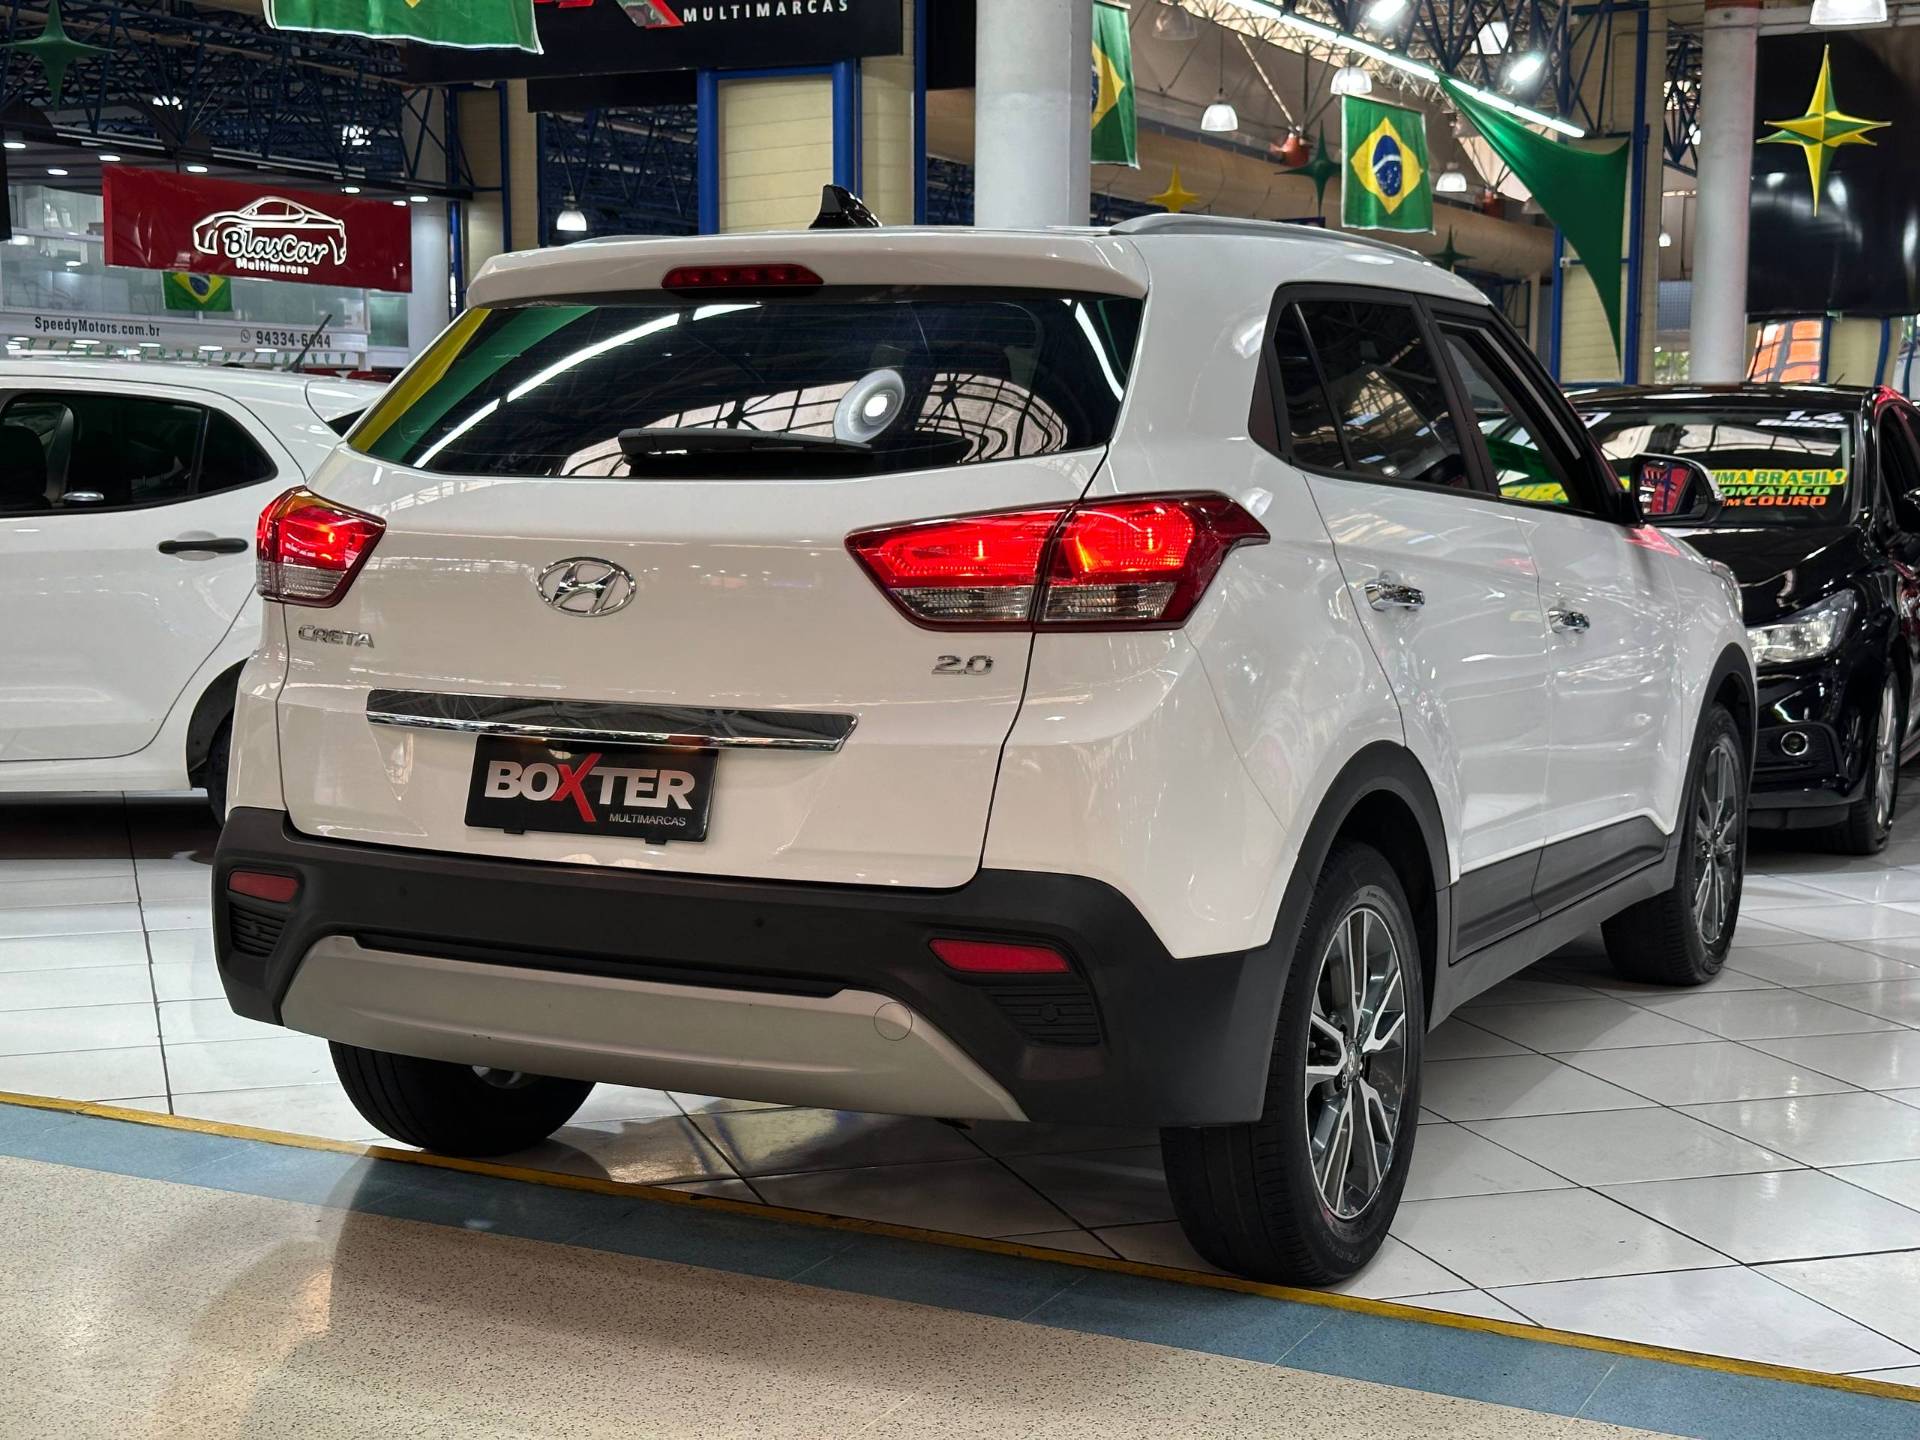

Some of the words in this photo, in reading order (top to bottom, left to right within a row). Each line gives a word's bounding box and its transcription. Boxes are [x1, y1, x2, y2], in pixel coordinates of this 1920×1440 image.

[683, 0, 849, 23] MULTIMARCAS
[222, 226, 329, 265] BlasCar
[235, 256, 310, 275] Multimarcas
[35, 316, 160, 336] SpeedyMotors.com.br
[1719, 486, 1831, 496] OMATICO
[1743, 496, 1828, 506] COURO
[298, 624, 375, 648] CRETA
[931, 655, 993, 675] 2.0
[484, 753, 698, 822] BOXTER
[609, 812, 687, 827] MULTIMARCAS
